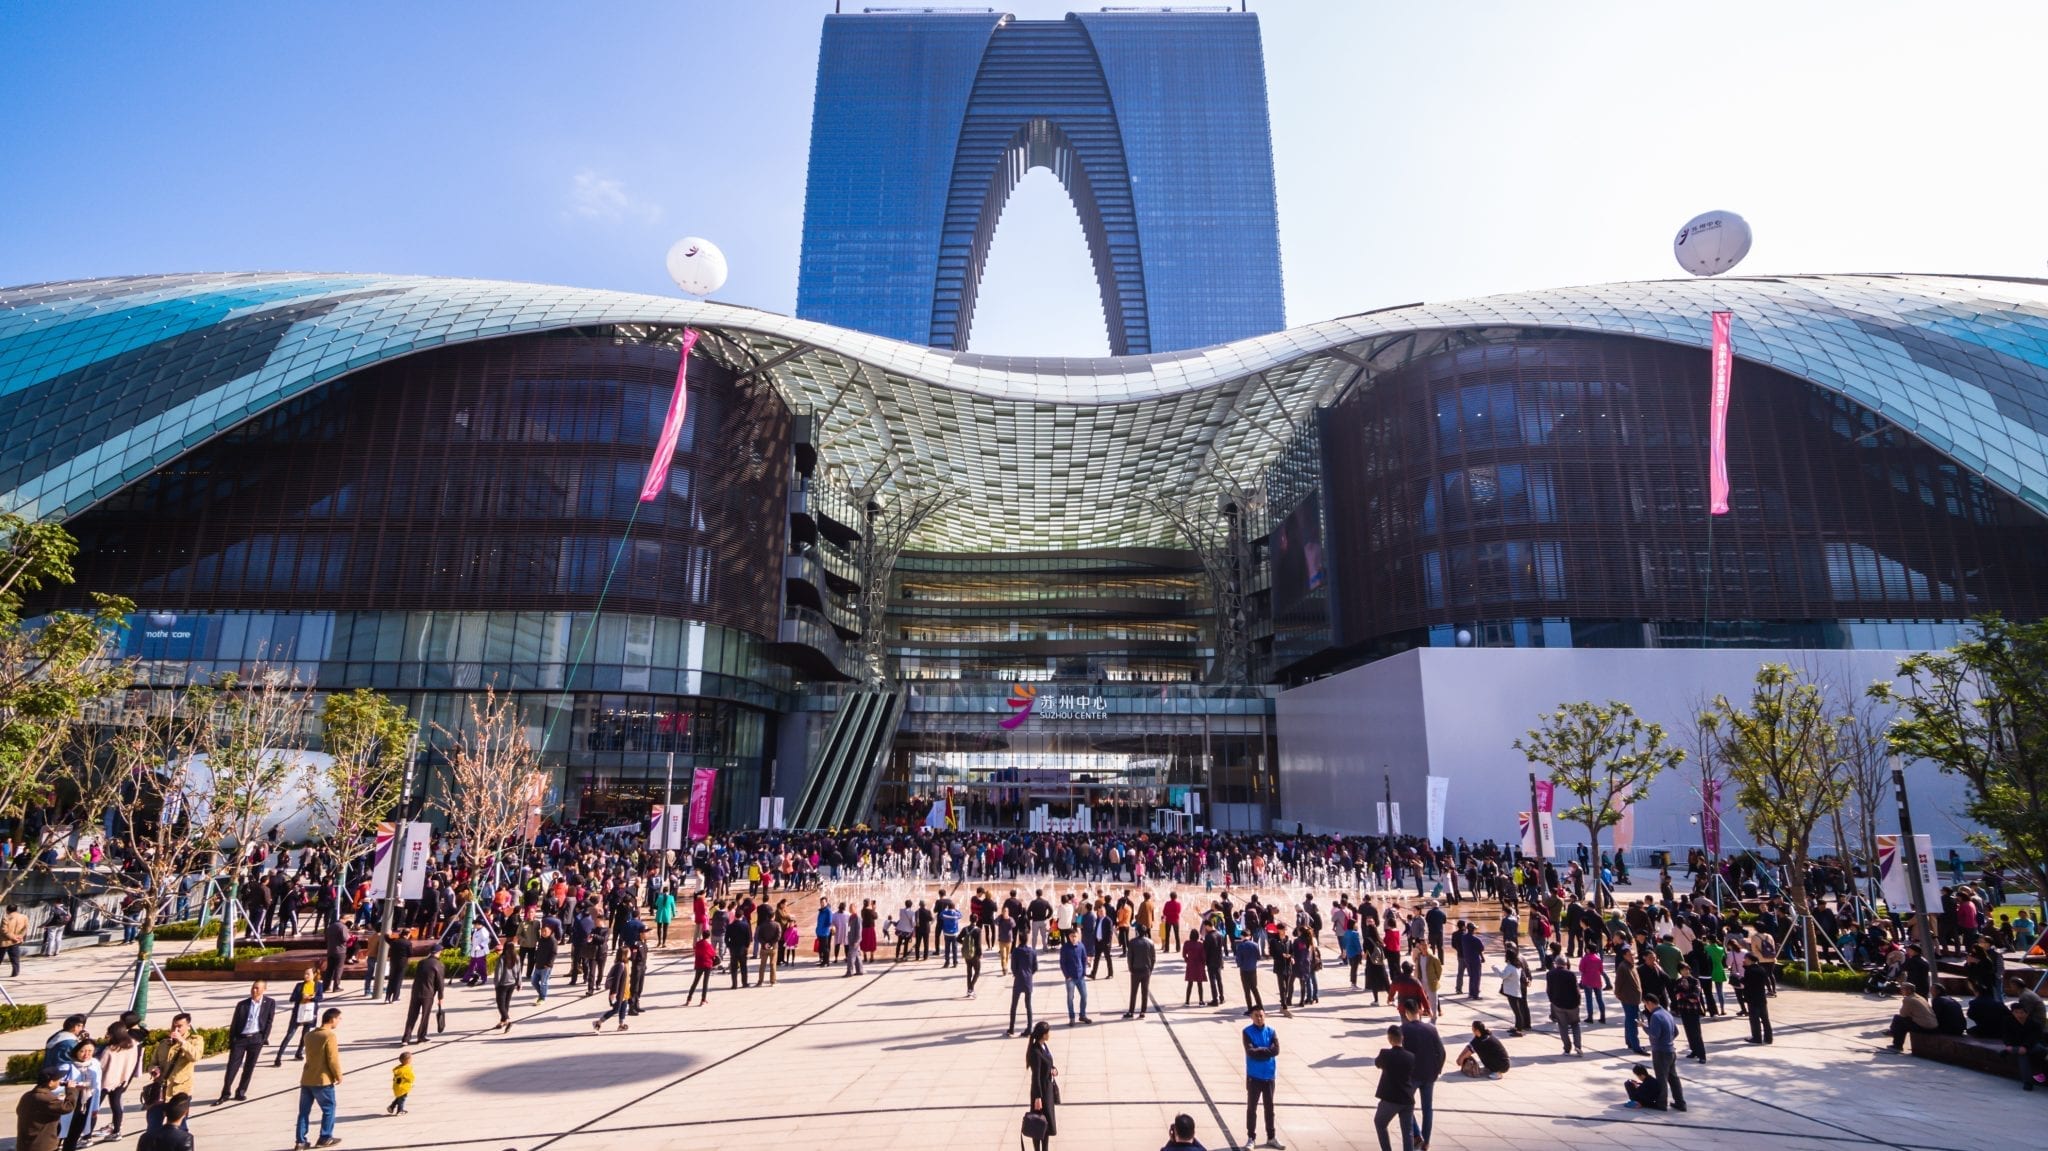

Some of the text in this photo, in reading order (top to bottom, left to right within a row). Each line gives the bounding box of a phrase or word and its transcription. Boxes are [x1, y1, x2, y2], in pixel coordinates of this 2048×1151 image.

[146, 630, 191, 639] mothecare
[1040, 695, 1107, 710] 苏州中心
[1040, 711, 1108, 720] SUZHOU CENTER
